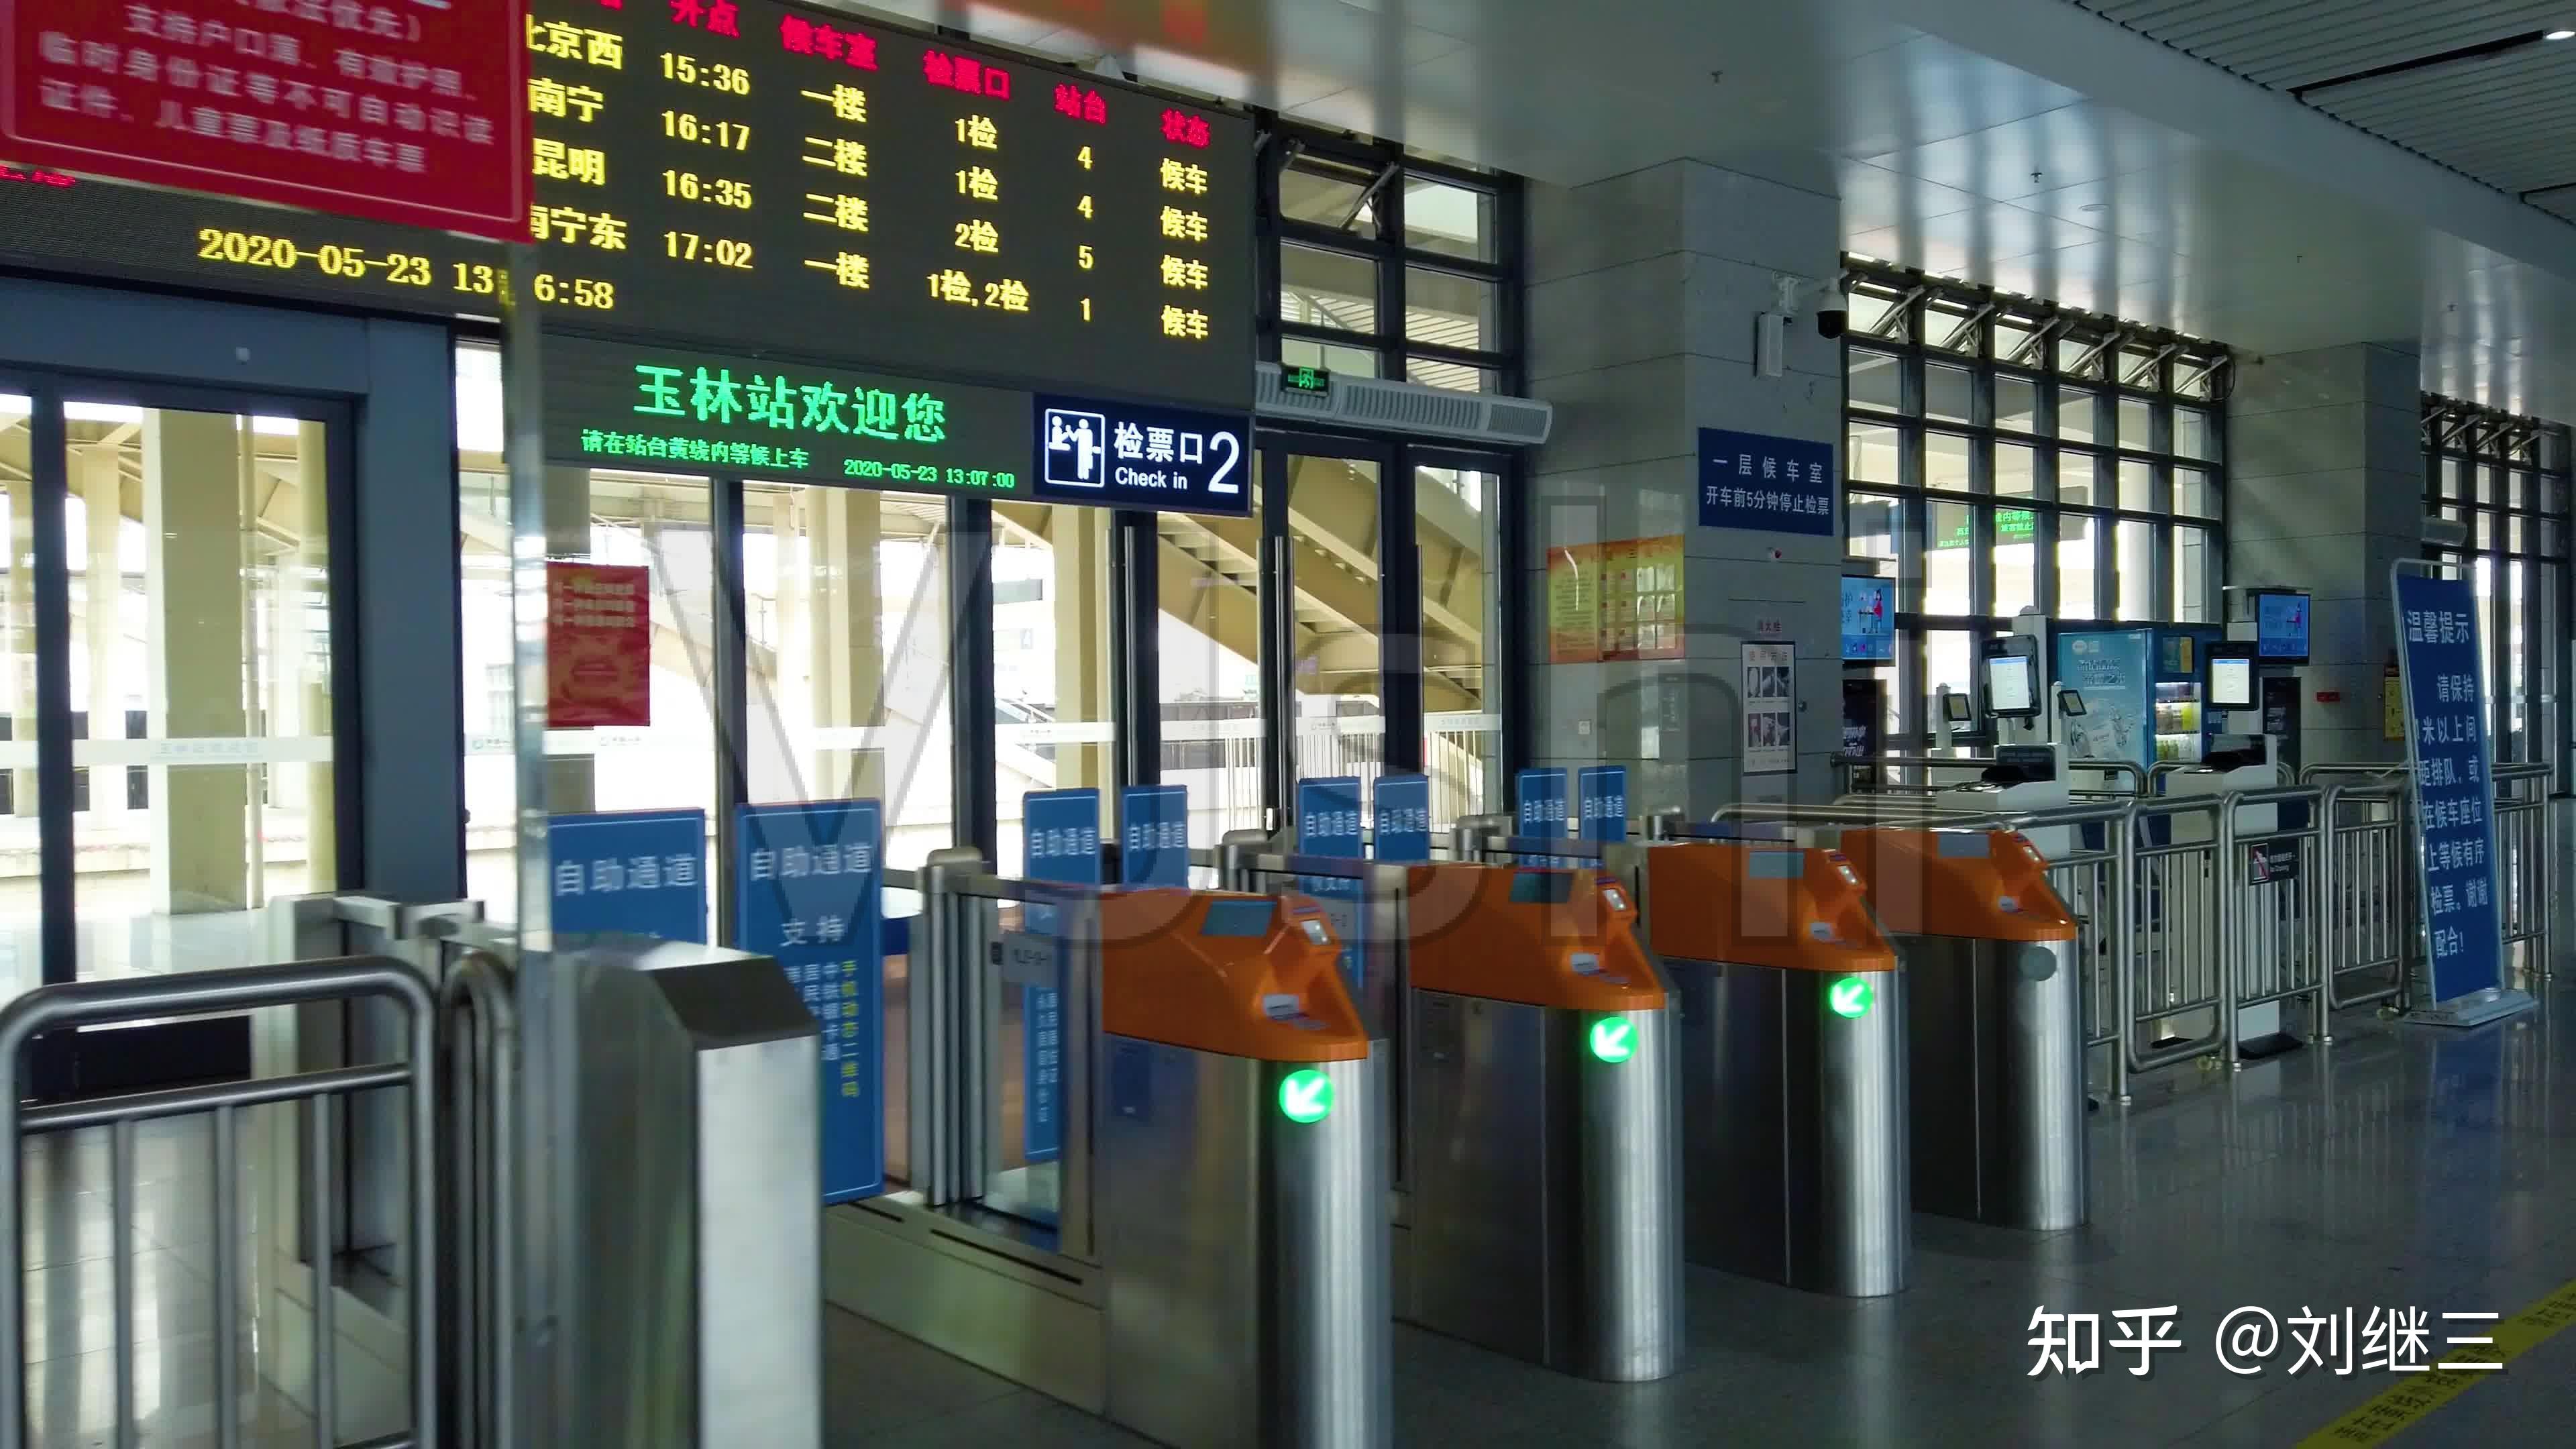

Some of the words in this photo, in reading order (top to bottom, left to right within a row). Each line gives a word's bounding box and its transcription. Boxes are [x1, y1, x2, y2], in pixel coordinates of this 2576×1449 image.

[781, 15, 877, 70] 候车室
[923, 50, 1009, 99] 检票口
[1055, 85, 1106, 124] 站台
[1162, 109, 1210, 147] 状态
[660, 52, 750, 95] 15:36
[801, 84, 867, 123] 一楼
[955, 114, 998, 150] 1检
[1077, 146, 1093, 170] 4
[1160, 158, 1208, 195] 候车
[527, 77, 604, 122] 南宁
[661, 110, 750, 151] 16:17
[802, 137, 867, 176] 二楼
[955, 166, 998, 201] 1检
[1077, 195, 1093, 219] 4
[1160, 205, 1208, 241] 候车
[532, 138, 605, 186] 昆明
[662, 170, 752, 209] 16:35
[803, 193, 869, 232] 二楼
[955, 219, 999, 253] 2检
[1078, 245, 1093, 269] 5
[1160, 254, 1208, 290] 候车
[197, 228, 431, 286] 2020-05-23
[663, 231, 753, 269] 17:02
[804, 252, 870, 288] 一楼
[1080, 298, 1090, 321] 1
[1161, 305, 1208, 339] 候车
[633, 364, 946, 443] 玉林站欢迎您
[580, 429, 809, 469] 请在站台黄线内等候上车
[1114, 421, 1203, 464] 检票口
[1208, 431, 1240, 494] 2
[843, 459, 938, 482] 2020-05-23
[946, 468, 1015, 488] 13:07:00
[1115, 466, 1167, 488] Check
[1173, 472, 1187, 490] in
[1713, 453, 1823, 484] 一层候车室
[1706, 485, 1829, 515] 开车前5分钟停止检票
[2407, 610, 2469, 644] 温馨提示
[2436, 674, 2475, 703] 请保持
[1303, 809, 1358, 838] 自助通道
[2422, 796, 2483, 831] 在候车座位
[1030, 826, 1096, 859] 自助通道
[1128, 821, 1187, 851] 自助通道
[749, 841, 872, 882] 自助通道
[2427, 837, 2485, 872] 上等候有序
[554, 853, 698, 897] 自助通道
[779, 915, 845, 947] 支持
